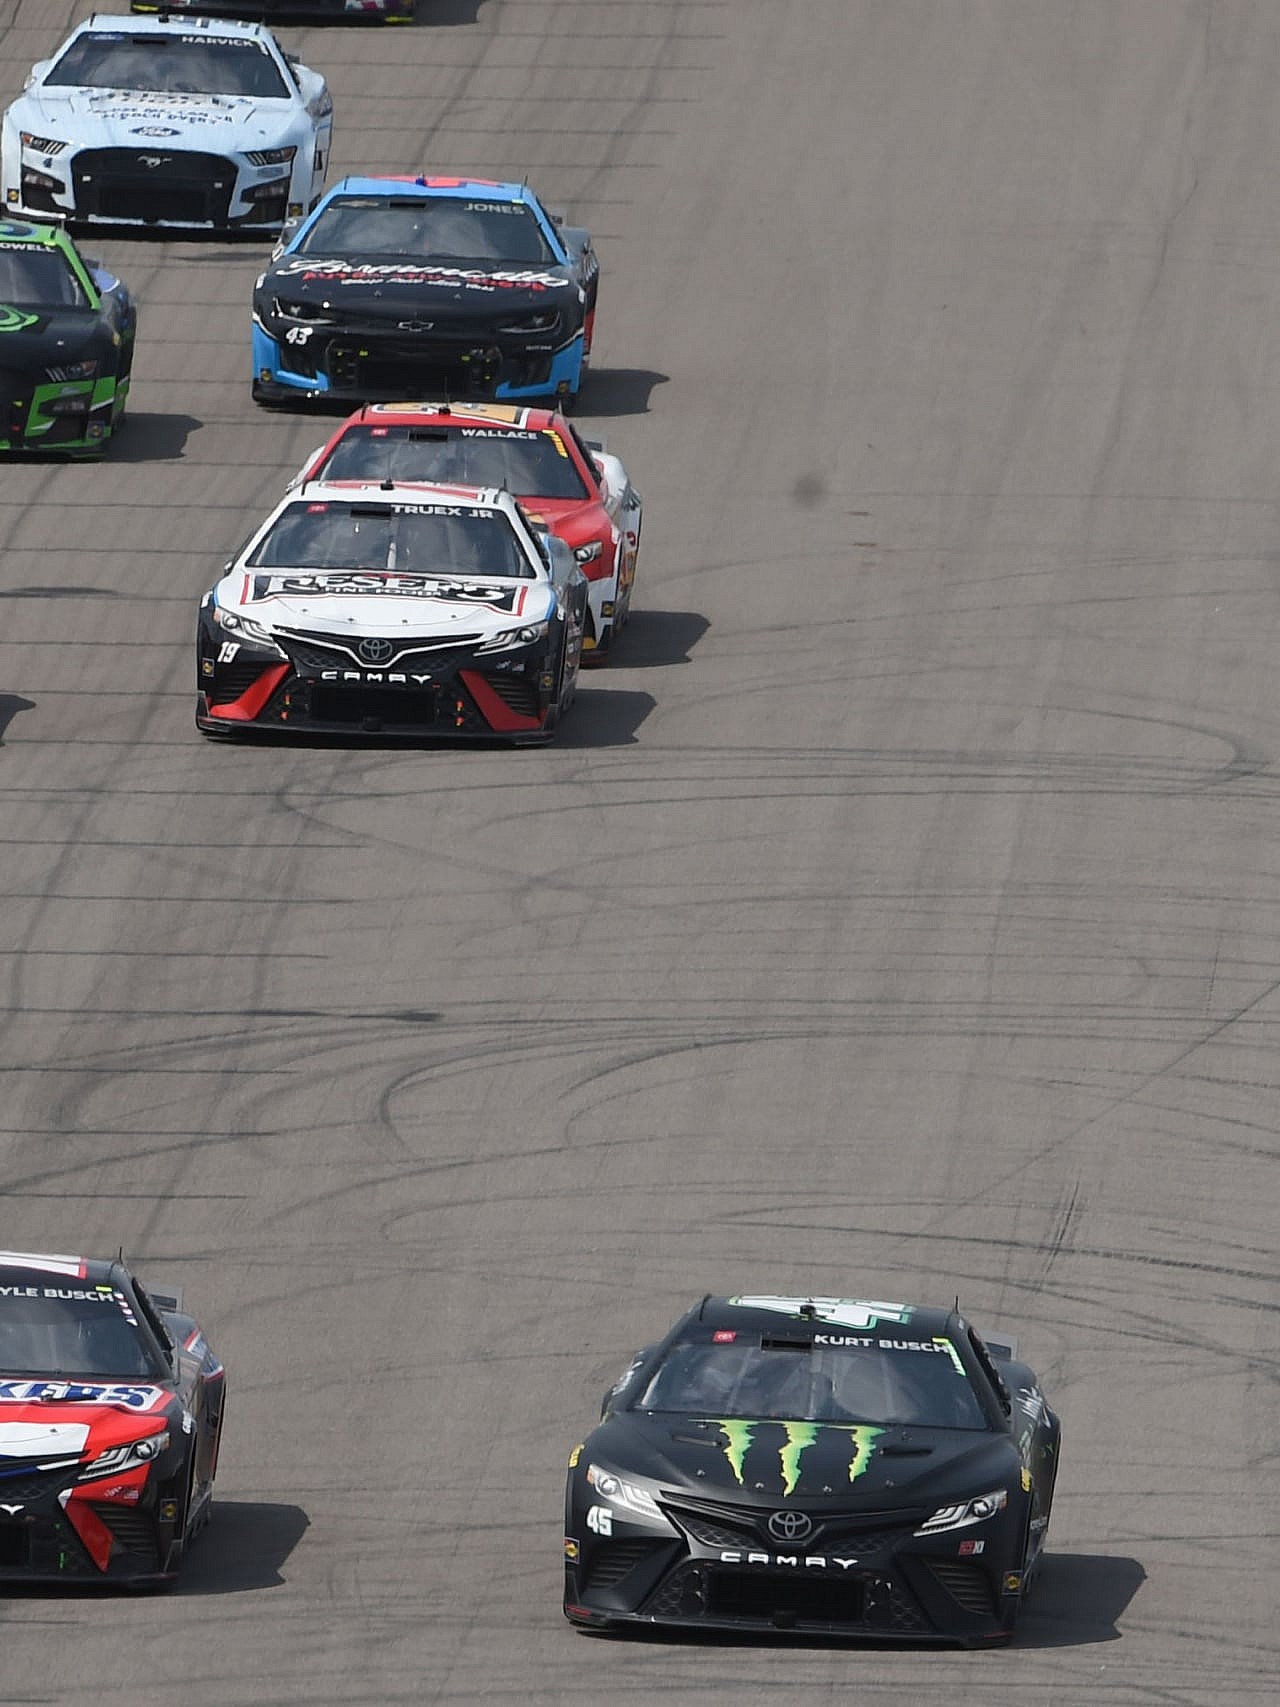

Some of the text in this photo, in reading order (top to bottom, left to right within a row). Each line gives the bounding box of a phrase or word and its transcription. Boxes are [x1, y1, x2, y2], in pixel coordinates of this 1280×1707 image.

[182, 36, 254, 47] HARVICK
[464, 202, 525, 215] JONES
[285, 327, 313, 345] 43
[461, 428, 538, 440] WALLACE
[391, 504, 494, 519] TRUEX JR
[217, 641, 241, 663] 19
[321, 671, 432, 684] CAMRY
[44, 1289, 115, 1303] BUSCH
[814, 1334, 949, 1353] KURT BUSCH
[586, 1505, 613, 1537] 45
[720, 1551, 859, 1569] CAMRY
